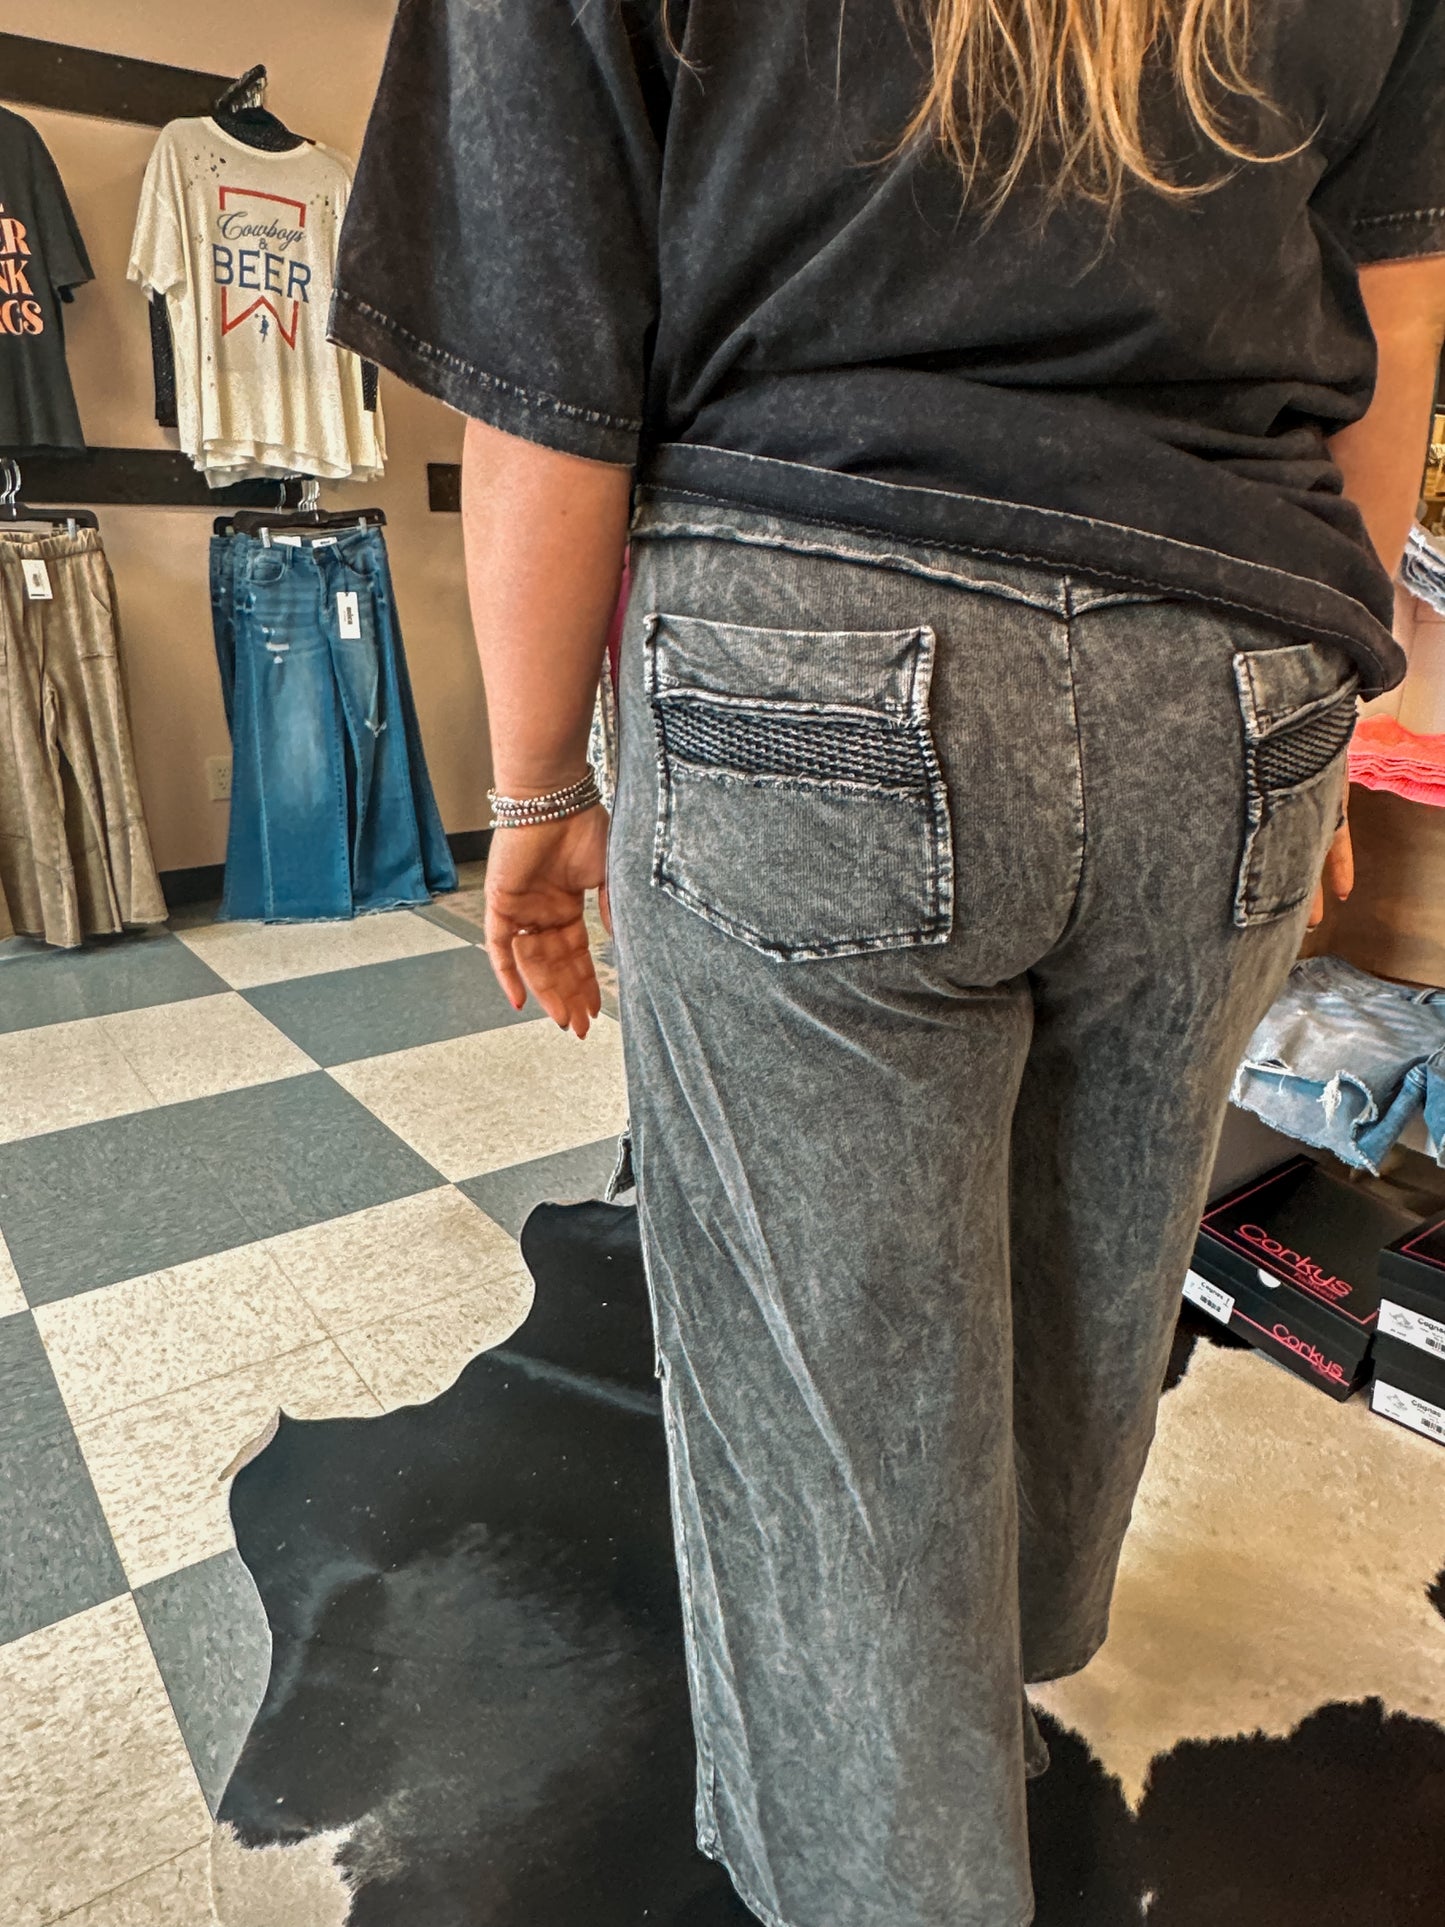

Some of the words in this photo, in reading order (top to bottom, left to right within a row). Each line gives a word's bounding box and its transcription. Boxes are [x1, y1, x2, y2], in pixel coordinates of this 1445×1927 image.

[0, 217, 32, 256] R
[216, 211, 306, 251] Cowboys
[259, 238, 269, 250] &
[213, 243, 312, 303] BEER
[0, 299, 44, 335] CS
[1240, 1224, 1353, 1298] Corkys
[1273, 1323, 1344, 1379] Corkys
